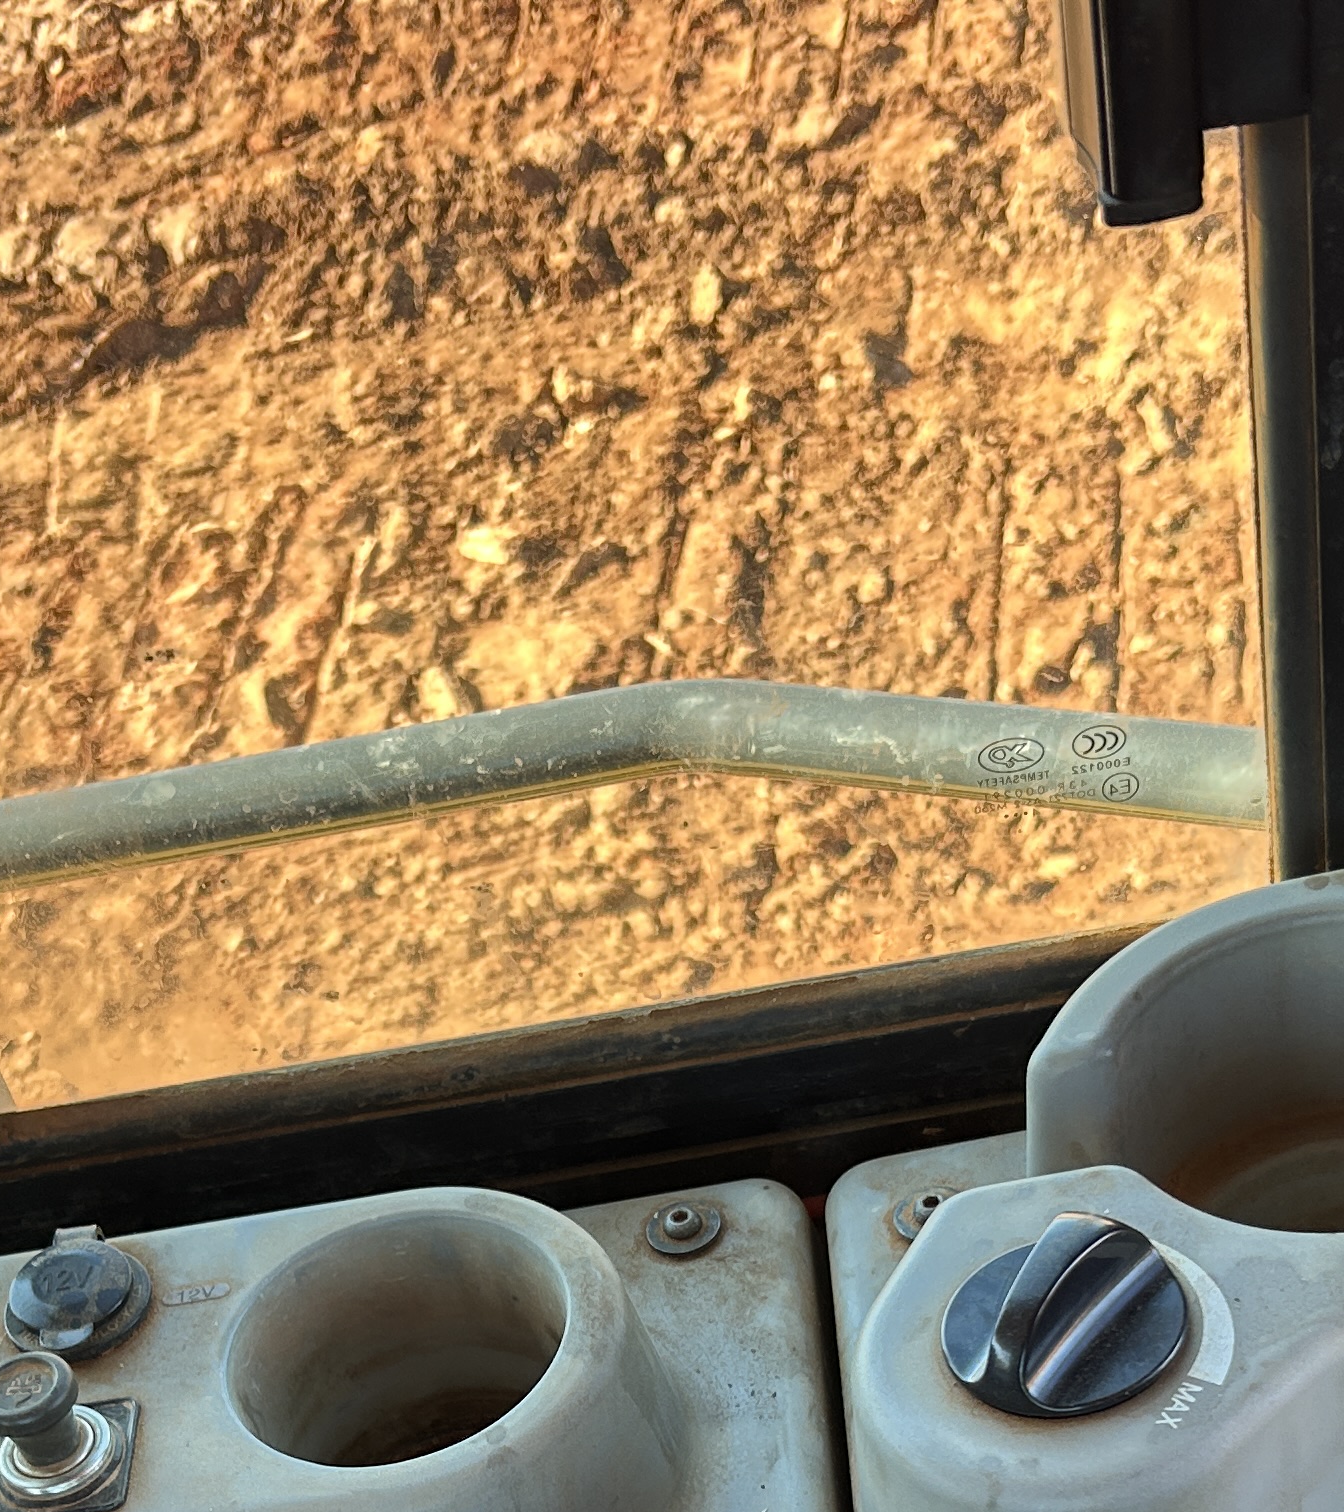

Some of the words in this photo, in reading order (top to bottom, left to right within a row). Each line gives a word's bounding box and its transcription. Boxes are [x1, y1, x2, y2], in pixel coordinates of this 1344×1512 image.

[40, 1264, 94, 1298] 12V
[176, 1285, 216, 1304] 12V
[1155, 1382, 1203, 1429] MAX
